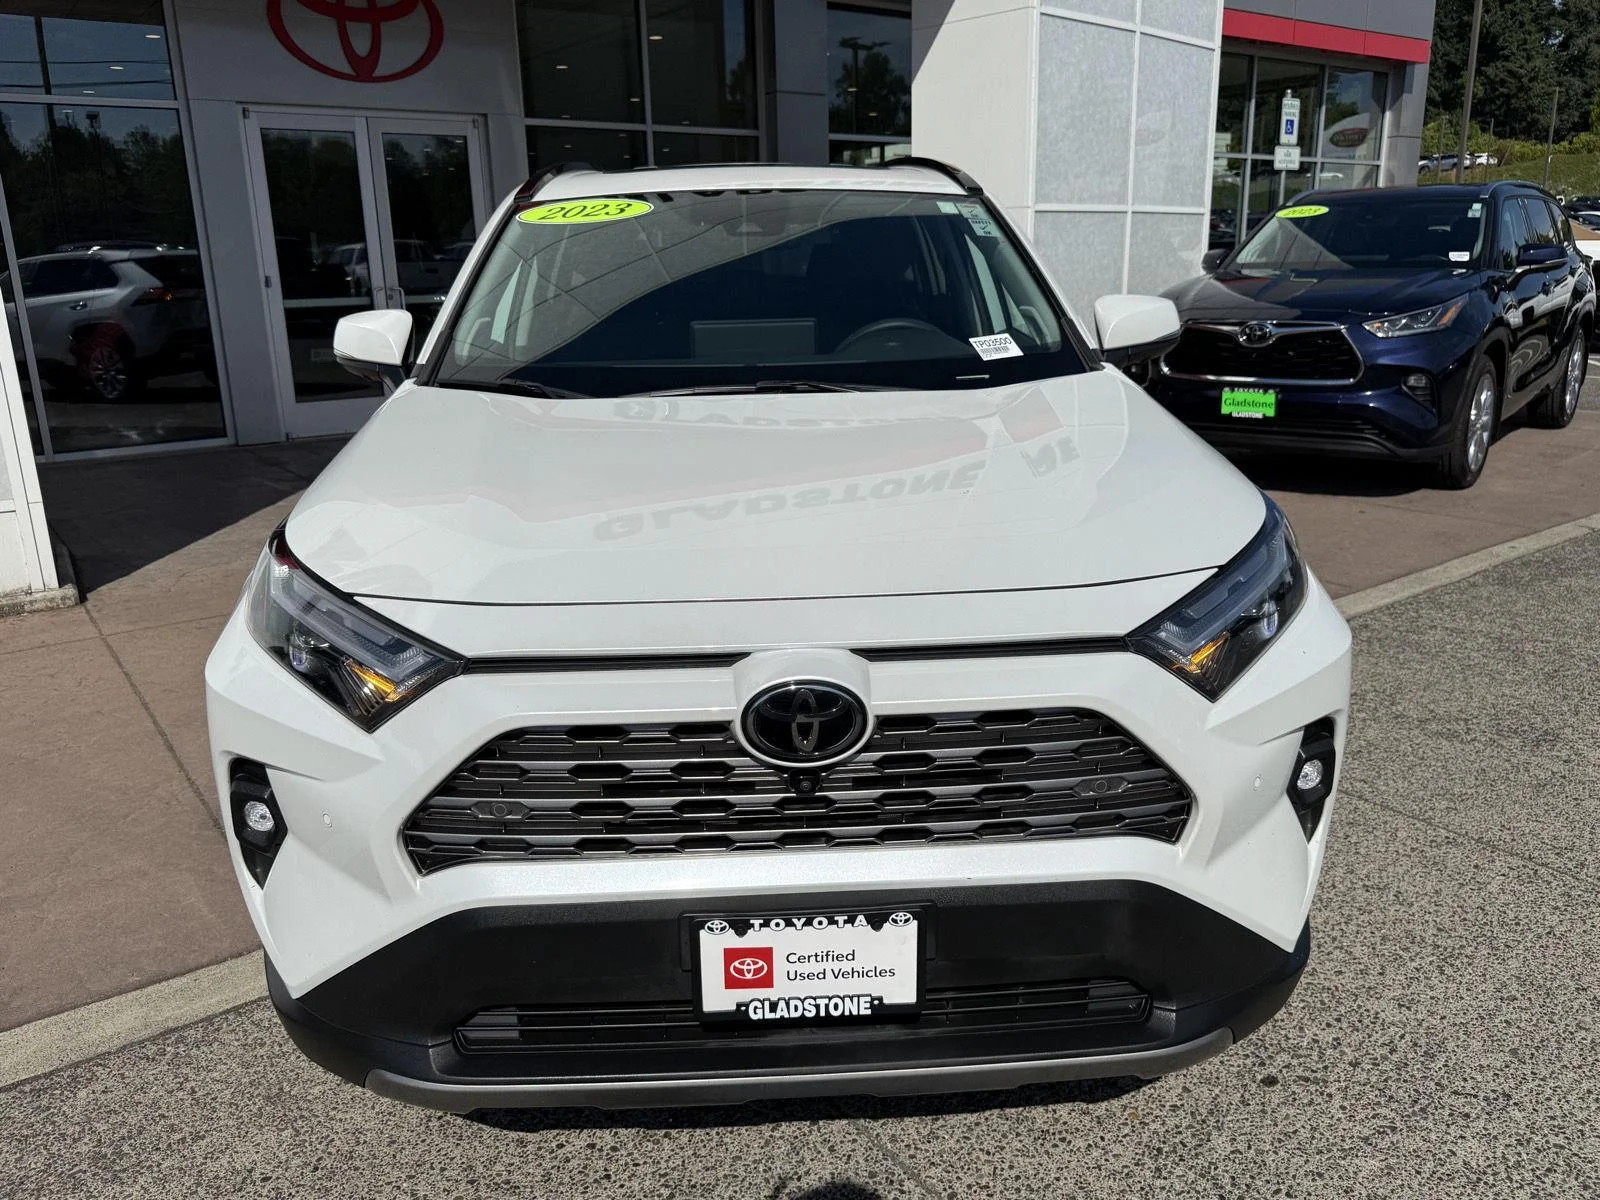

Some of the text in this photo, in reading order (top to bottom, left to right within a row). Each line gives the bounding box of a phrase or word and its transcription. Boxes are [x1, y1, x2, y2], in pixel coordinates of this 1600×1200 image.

[538, 202, 632, 220] 2023
[972, 336, 1012, 349] TP03500
[1223, 397, 1274, 409] Gladstone
[1231, 411, 1264, 419] GLADSTONE
[750, 914, 868, 931] TOYOTA
[785, 949, 856, 964] Certified
[786, 966, 896, 981] Used Vehicles
[748, 996, 872, 1020] GLADSTONE
